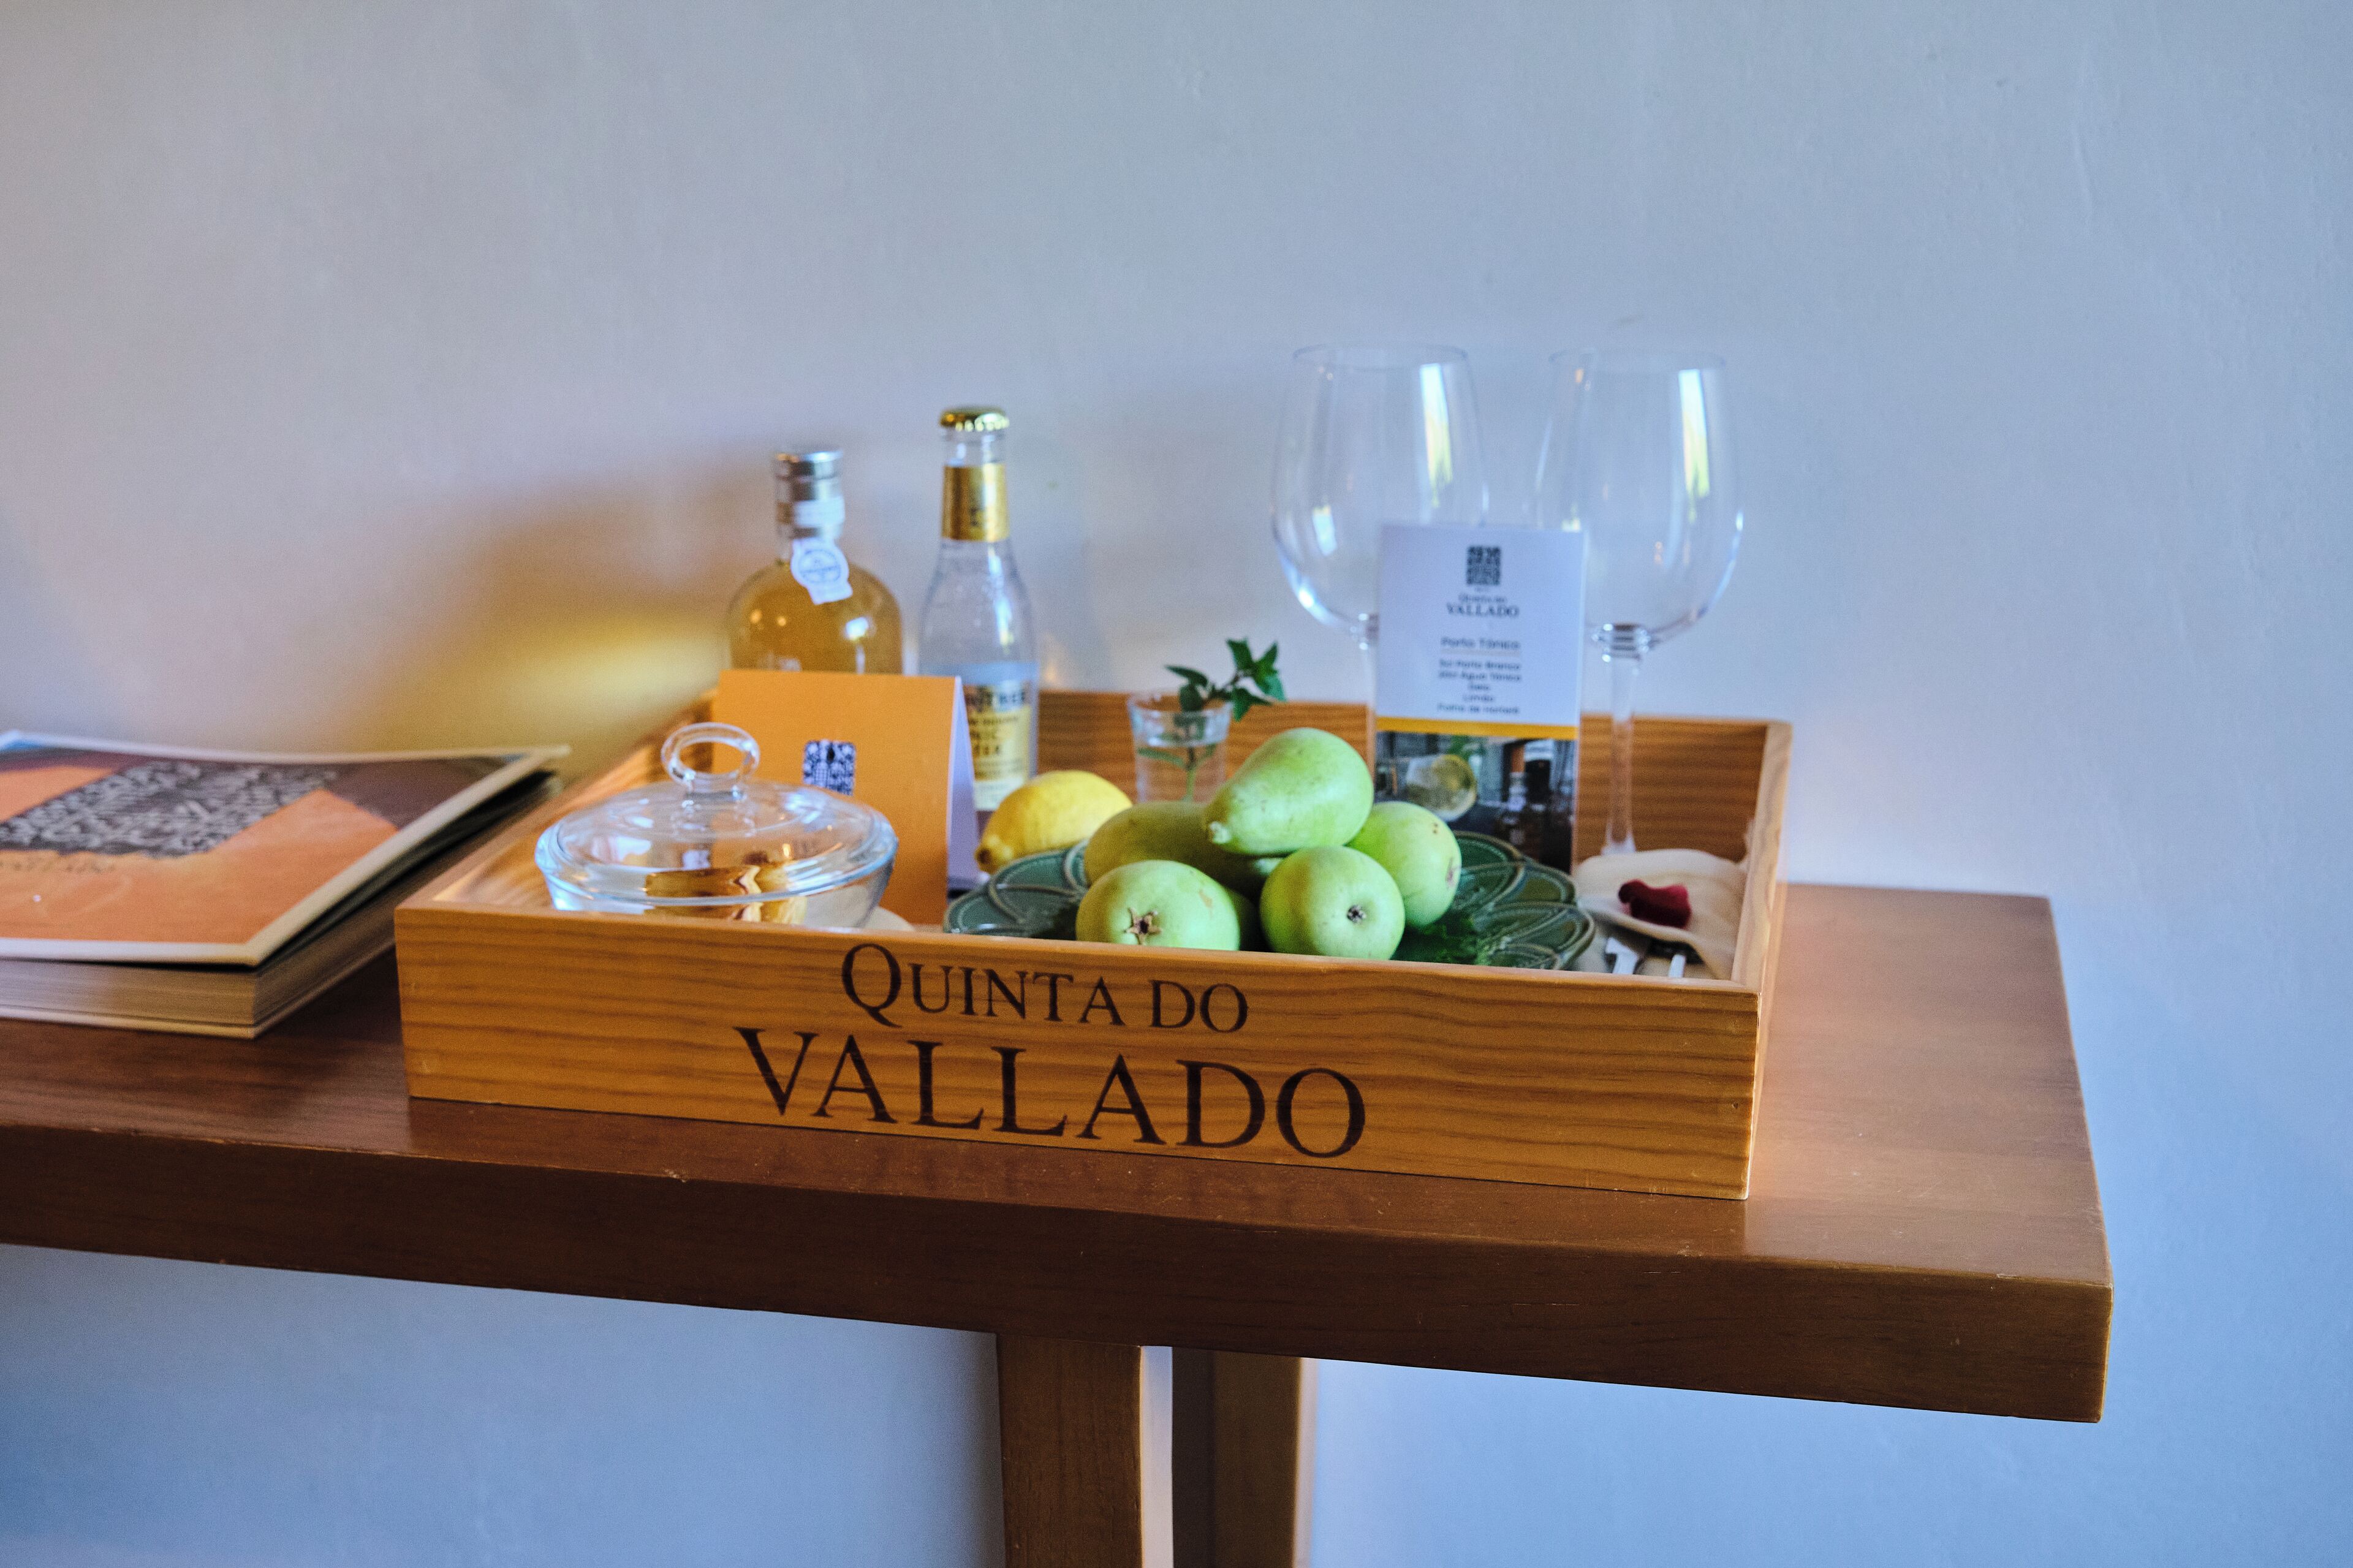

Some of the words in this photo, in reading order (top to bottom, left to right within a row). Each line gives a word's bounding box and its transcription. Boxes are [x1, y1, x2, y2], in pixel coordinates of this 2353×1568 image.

[1446, 602, 1520, 617] VALLADO
[842, 943, 1126, 1028] QUINTA
[1148, 980, 1249, 1032] DO
[735, 1027, 1365, 1158] VALLADO
